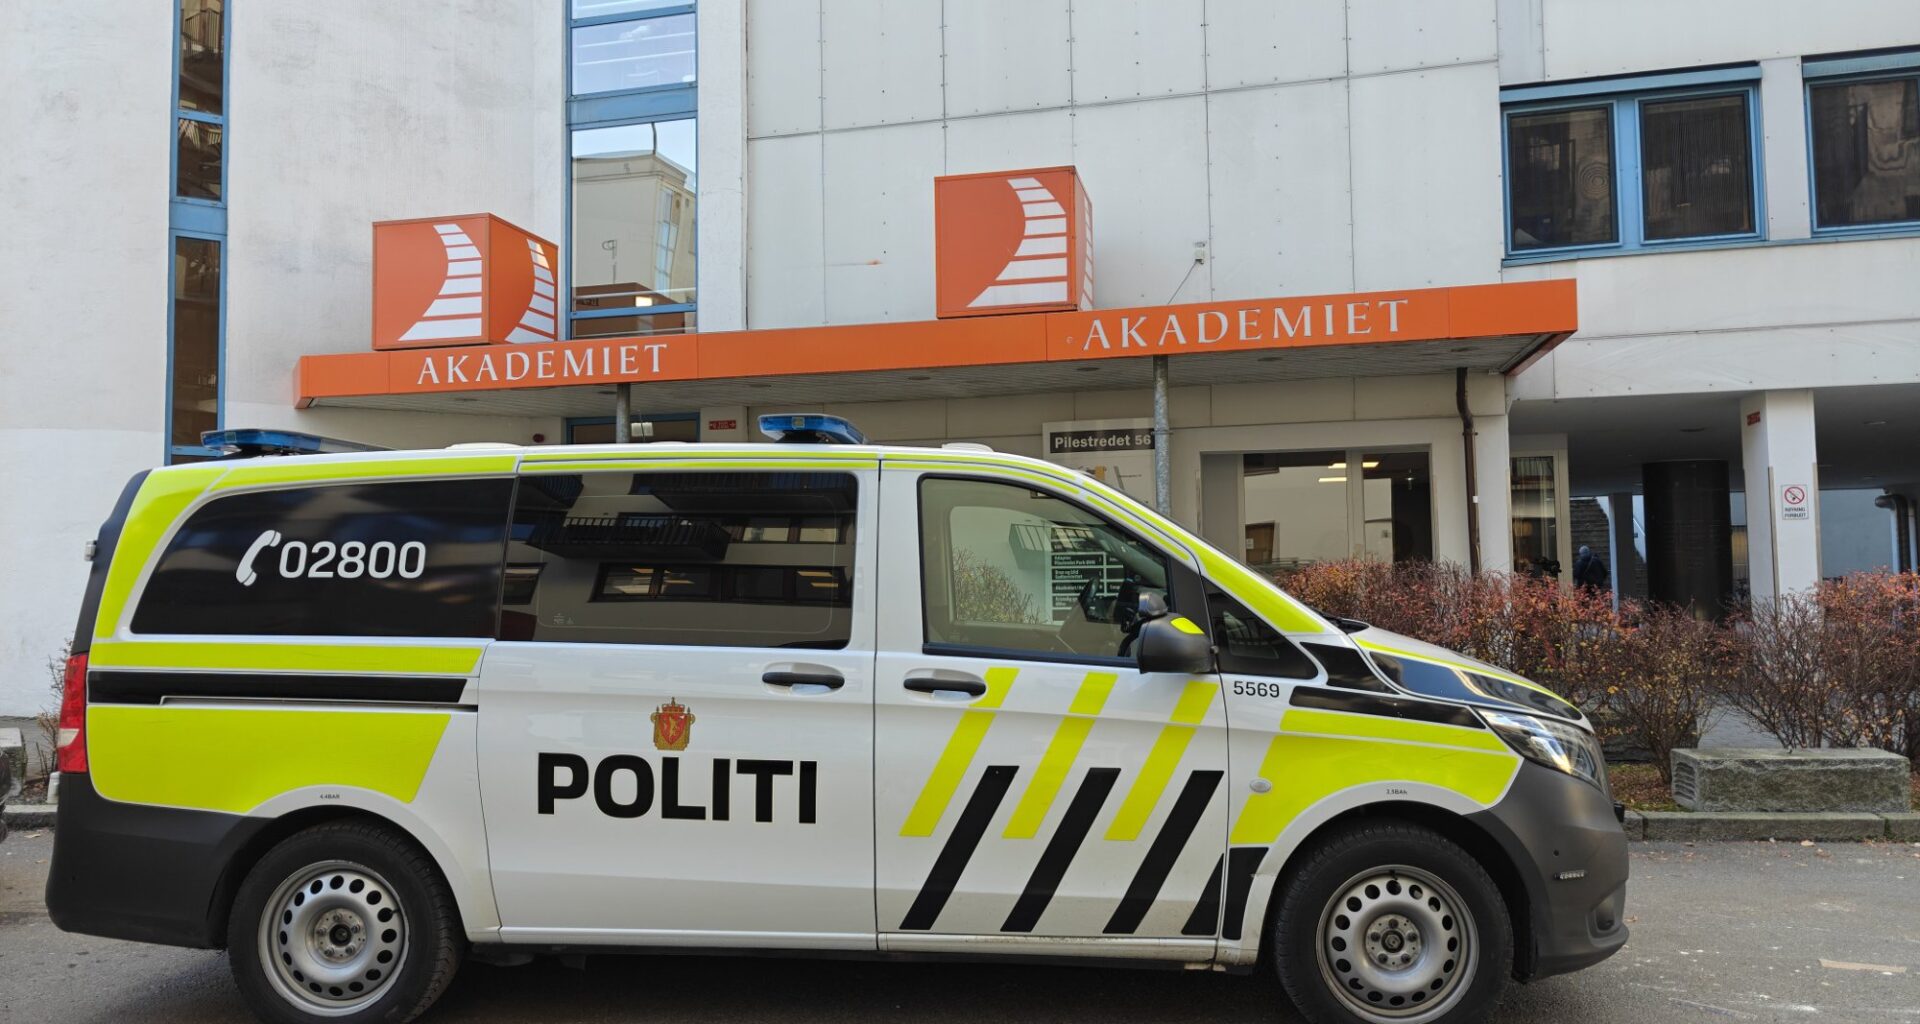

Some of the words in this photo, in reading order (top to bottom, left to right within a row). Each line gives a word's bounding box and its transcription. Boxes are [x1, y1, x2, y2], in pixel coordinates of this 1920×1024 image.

[1083, 299, 1408, 350] AKADEMIET
[417, 344, 667, 384] AKADEMIET
[1055, 434, 1130, 449] Pilestredet
[1135, 434, 1152, 446] 56
[279, 541, 426, 579] 02800
[1233, 680, 1280, 698] 5569
[537, 752, 818, 824] POLITI
